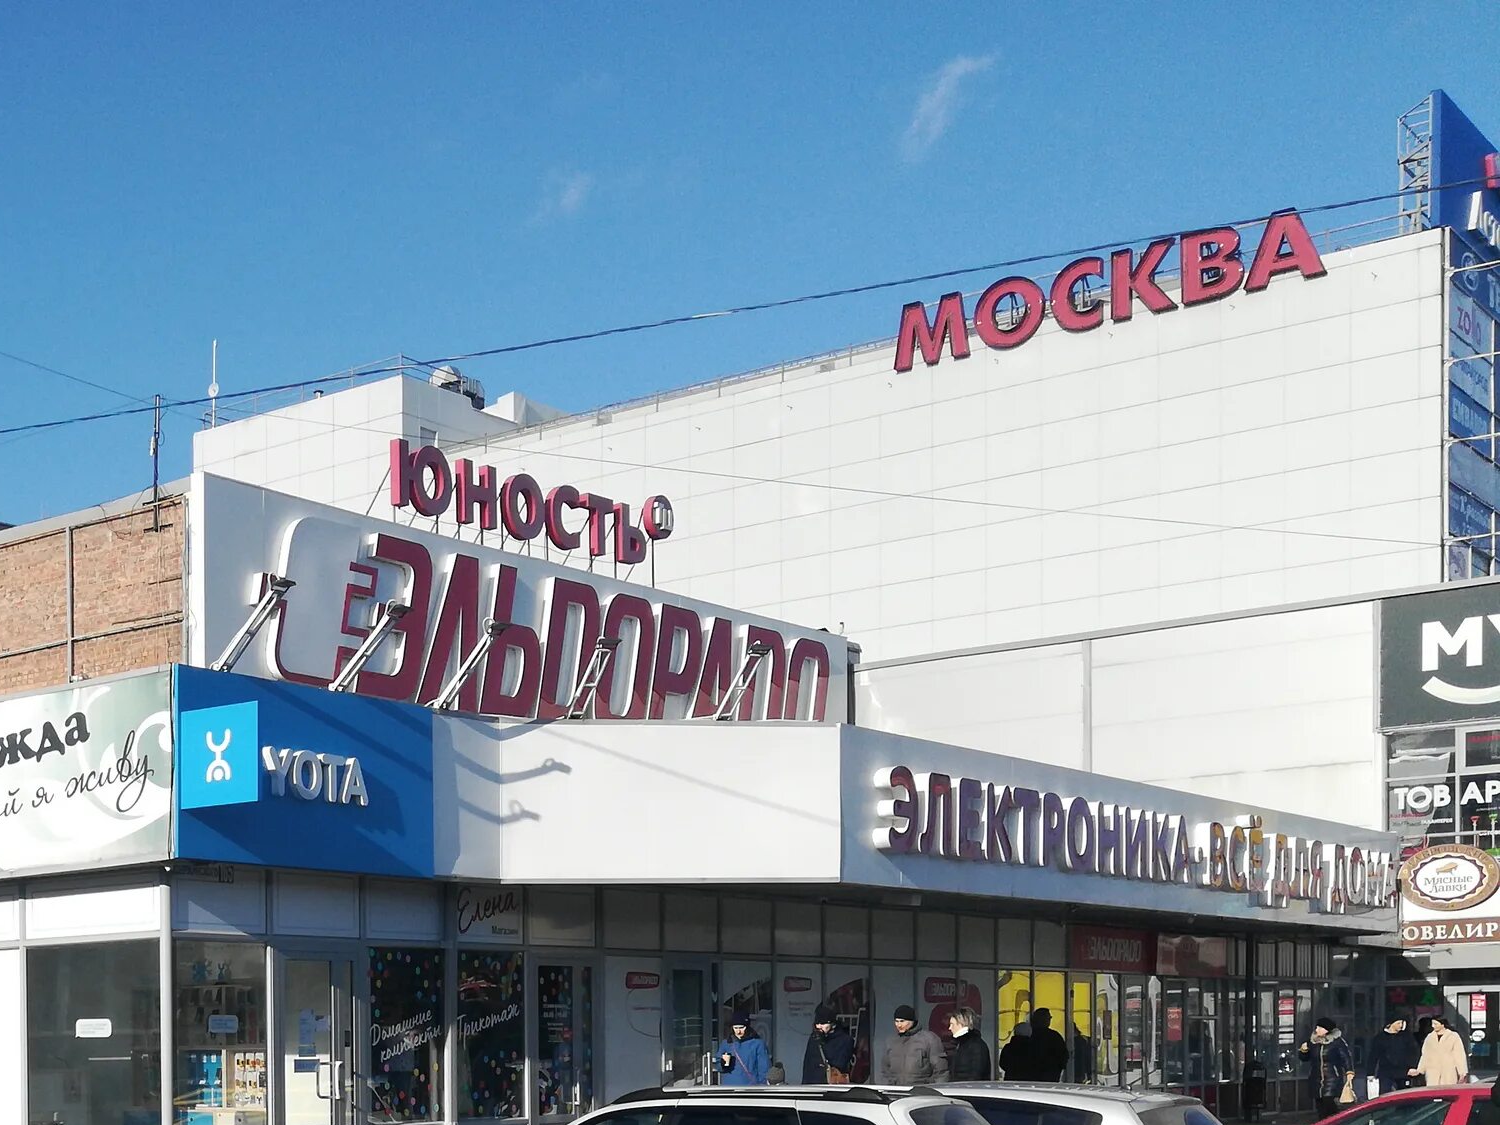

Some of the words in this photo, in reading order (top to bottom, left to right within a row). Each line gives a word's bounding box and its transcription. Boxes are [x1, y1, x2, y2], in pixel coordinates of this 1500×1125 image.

[893, 206, 1328, 374] МОСКВА
[390, 438, 646, 564] ЮНОСТЬ
[30, 783, 55, 809] я
[64, 730, 155, 812] живу
[262, 744, 369, 806] YOTA
[874, 765, 1191, 883] ЭЛЕКТРОНИКА
[1267, 833, 1322, 909] ДЛЯ
[1424, 875, 1474, 886] Мясные
[1429, 884, 1468, 893] Лавки
[457, 887, 517, 934] Елена
[491, 926, 519, 936] Магазин
[370, 1008, 433, 1046] Домашние
[380, 1024, 442, 1062] комплекты
[457, 1002, 521, 1050] Трикотаж
